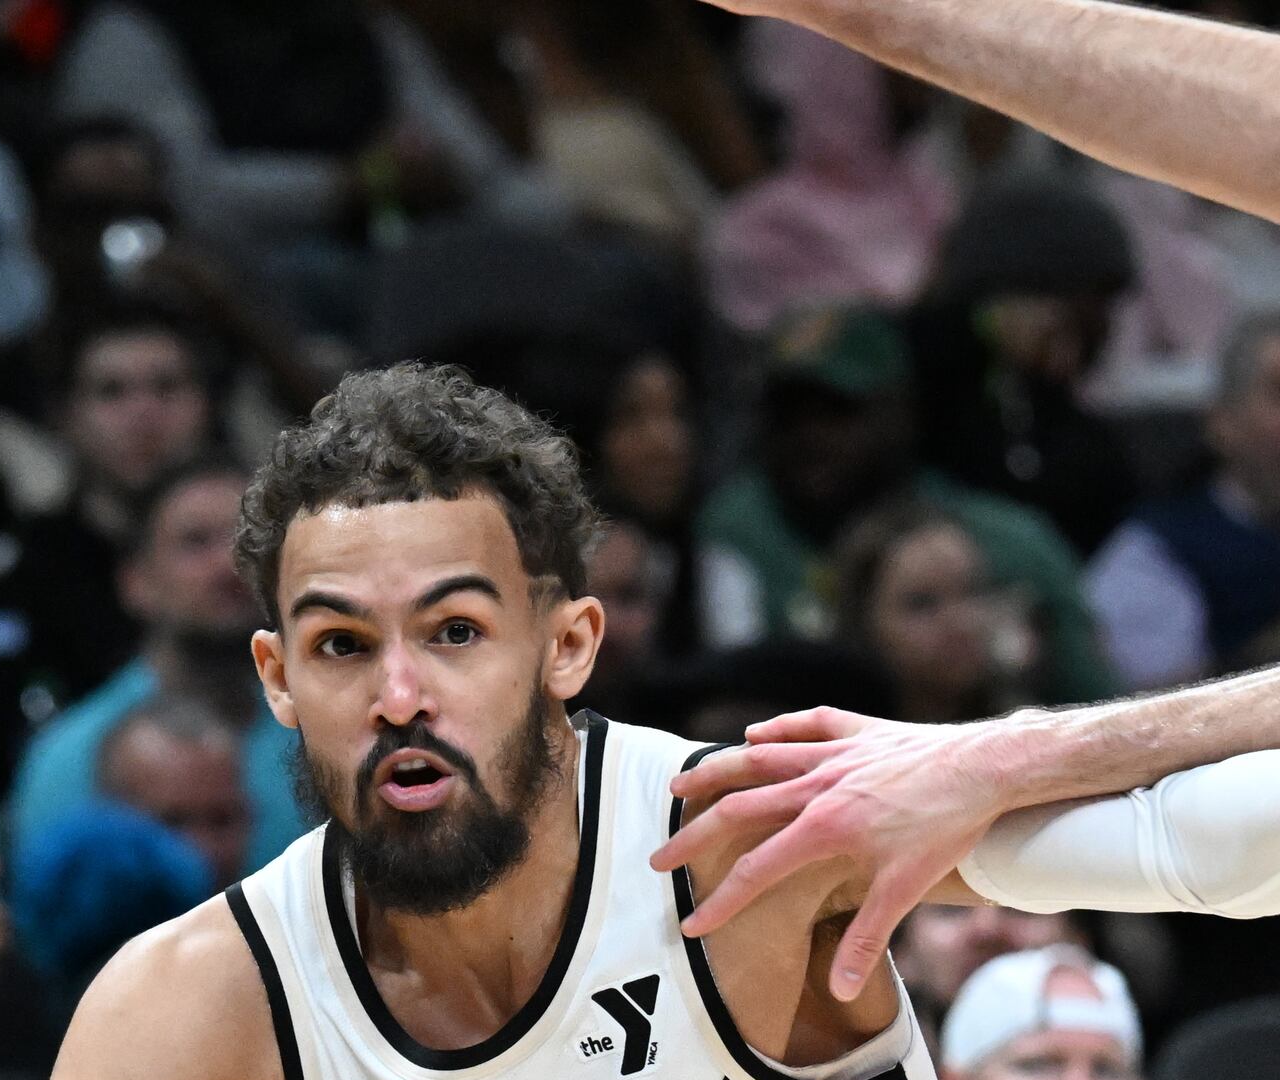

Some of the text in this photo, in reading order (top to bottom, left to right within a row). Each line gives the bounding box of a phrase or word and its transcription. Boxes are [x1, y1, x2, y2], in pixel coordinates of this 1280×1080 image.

[579, 974, 660, 1076] the Y
[647, 1042, 658, 1066] YMCA
